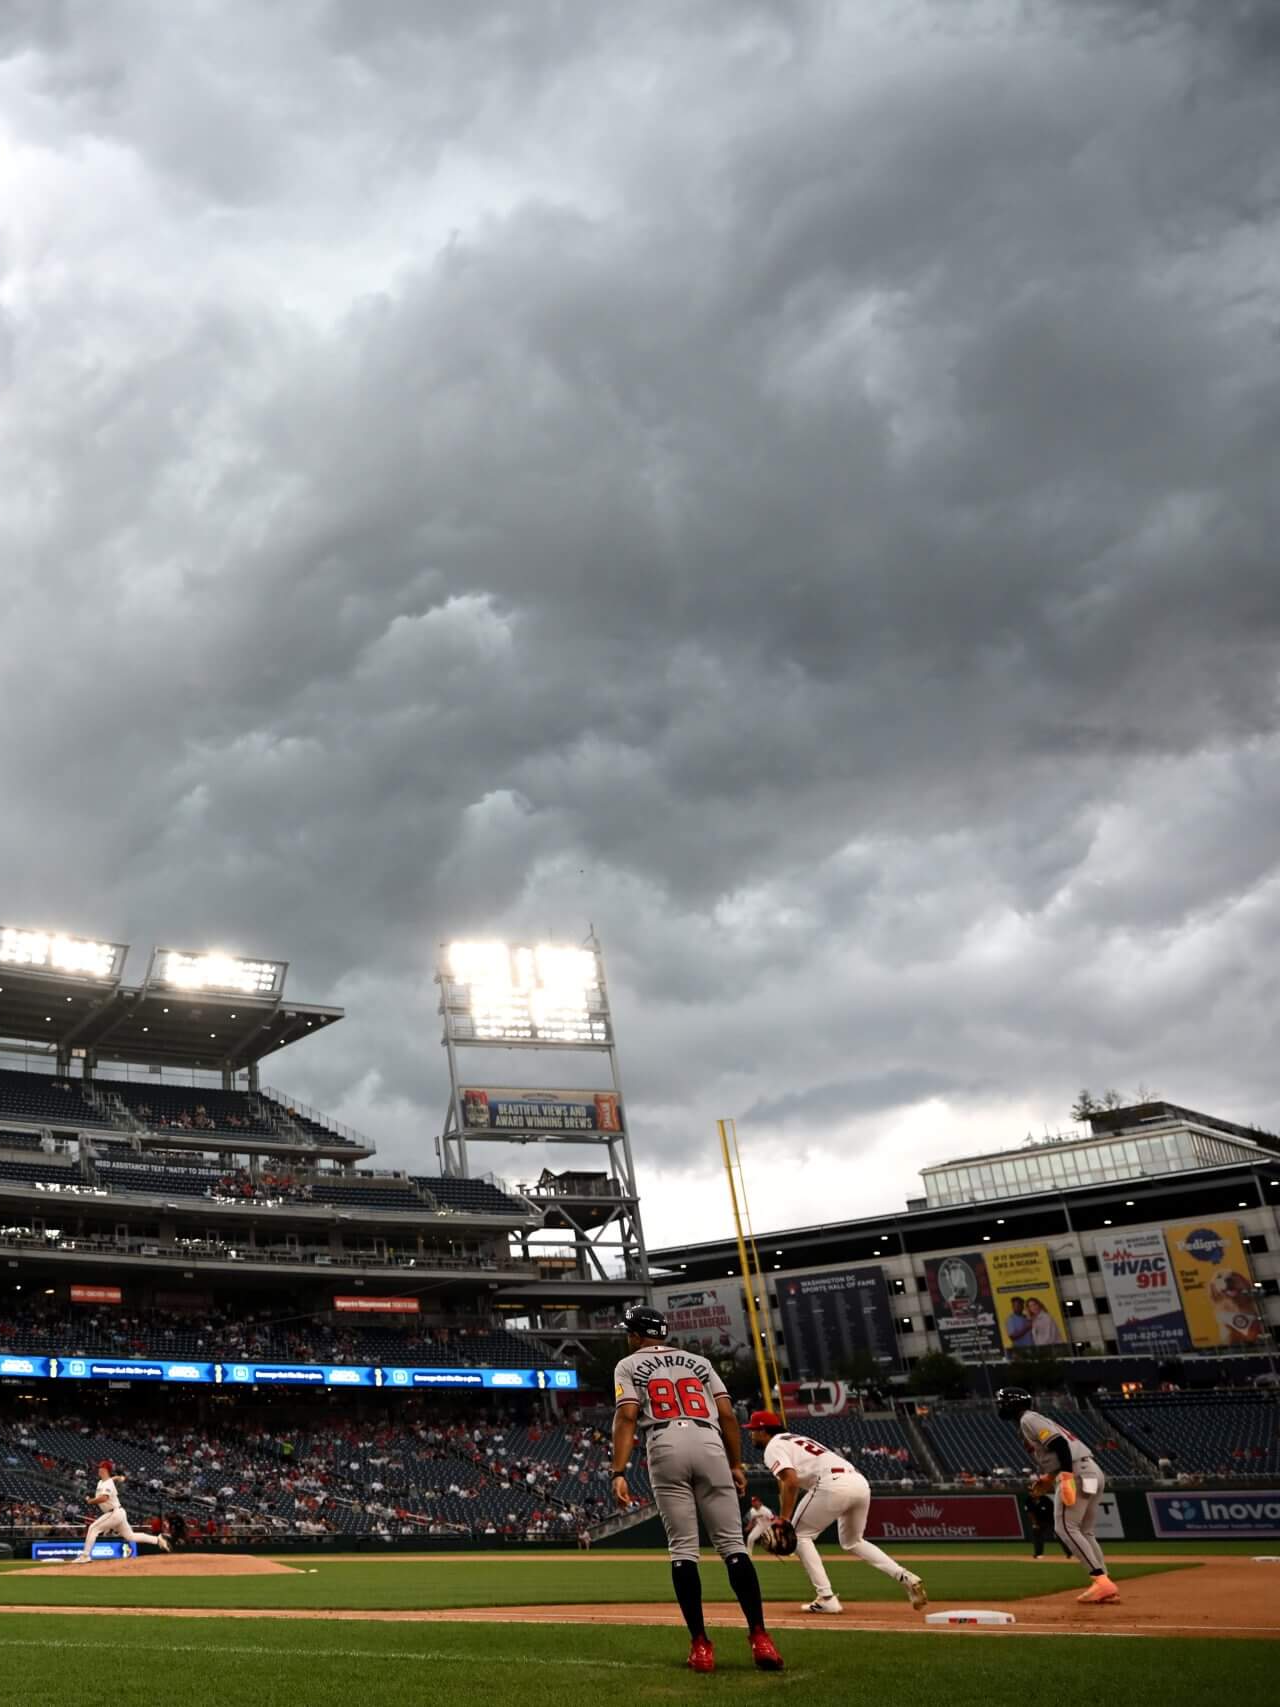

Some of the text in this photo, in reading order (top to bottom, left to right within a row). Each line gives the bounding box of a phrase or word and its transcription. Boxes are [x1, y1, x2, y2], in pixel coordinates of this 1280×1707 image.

[498, 1103, 541, 1115] BEAUTIFUL
[542, 1104, 569, 1116] VIEWS
[570, 1106, 587, 1116] AND
[495, 1115, 593, 1129] AWARD WINNING BREWS
[1113, 1257, 1166, 1276] HVAC
[800, 1274, 856, 1287] WASHINGTON DC
[801, 1279, 876, 1294] SPORTS HALL OF FAME
[1136, 1271, 1167, 1289] 911
[699, 1315, 732, 1329] BASEBALL
[633, 1355, 711, 1388] RICHARDSON
[647, 1377, 710, 1420] 86
[1200, 1499, 1280, 1521] Inova
[881, 1521, 977, 1537] Budweiser
